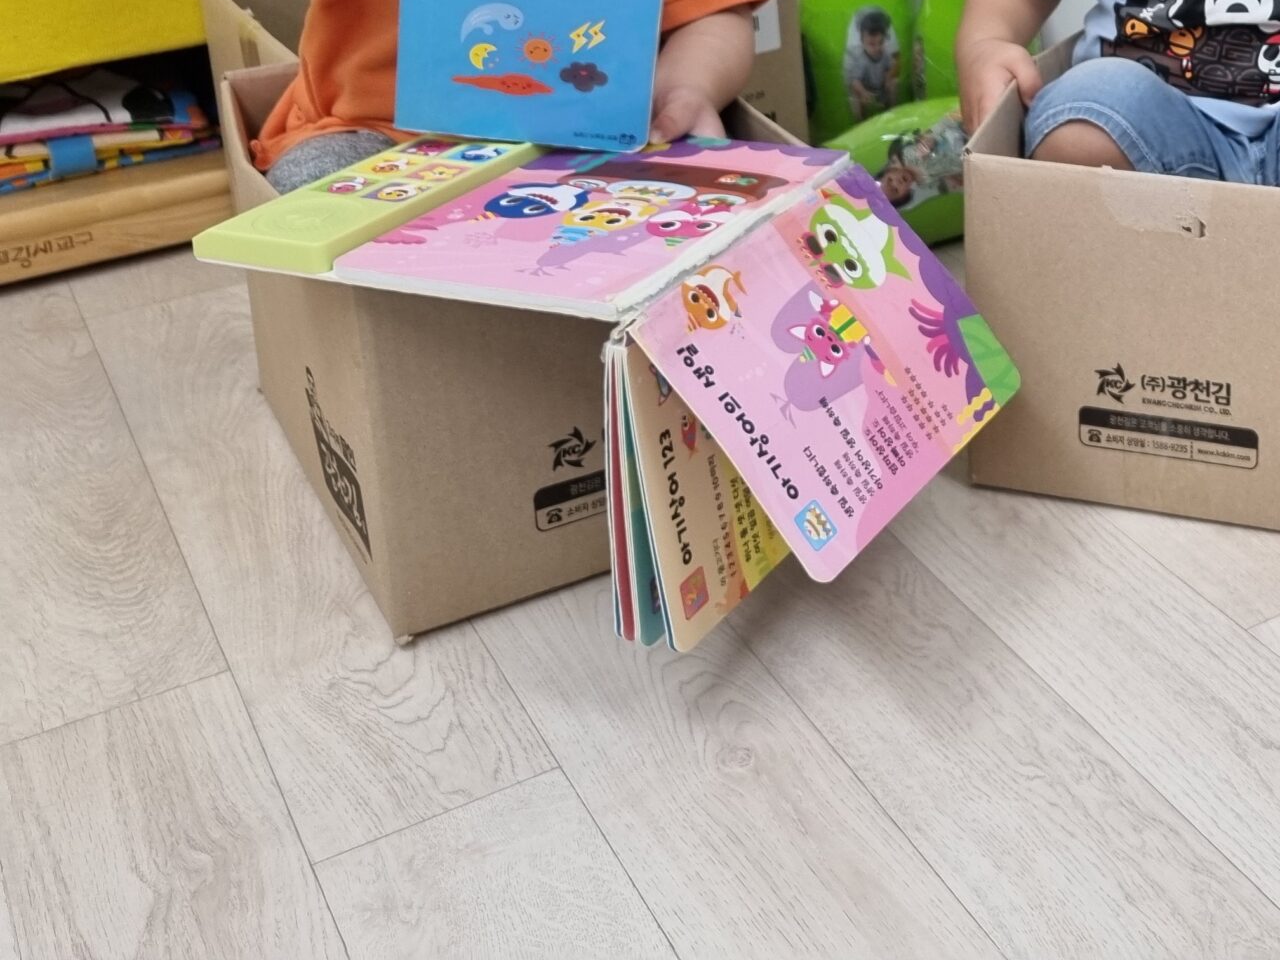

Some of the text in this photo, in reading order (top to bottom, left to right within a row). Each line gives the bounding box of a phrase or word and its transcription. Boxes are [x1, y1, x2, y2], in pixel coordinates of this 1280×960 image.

[676, 343, 799, 500] 아기상어의 생일
[1104, 378, 1124, 391] KC
[1140, 373, 1232, 406] (주)광천김
[802, 445, 856, 518] 생일 축하합니다
[818, 396, 884, 490] 아기상어 생일 축하해
[659, 428, 693, 566] 아기상어 123
